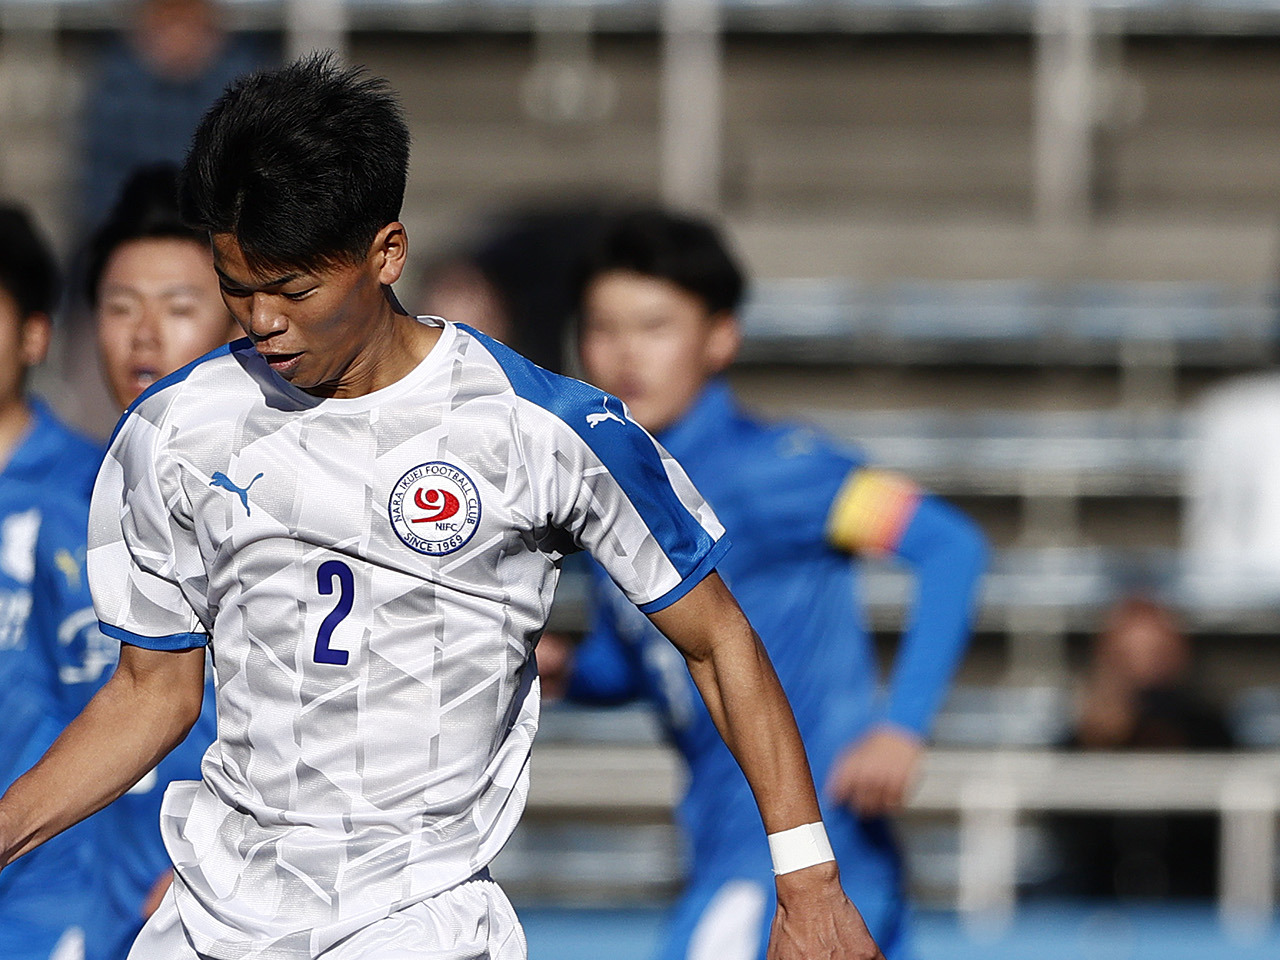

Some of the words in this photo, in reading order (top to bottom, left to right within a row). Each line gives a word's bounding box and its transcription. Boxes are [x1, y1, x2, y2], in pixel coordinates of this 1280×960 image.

[393, 492, 404, 522] NARA
[400, 469, 423, 490] IKUEI
[426, 465, 472, 495] FOOTBALL
[467, 498, 478, 525] CLUB
[404, 532, 433, 552] SINCE
[437, 534, 464, 552] 1969
[435, 522, 458, 532] NIFC
[313, 560, 355, 666] 2
